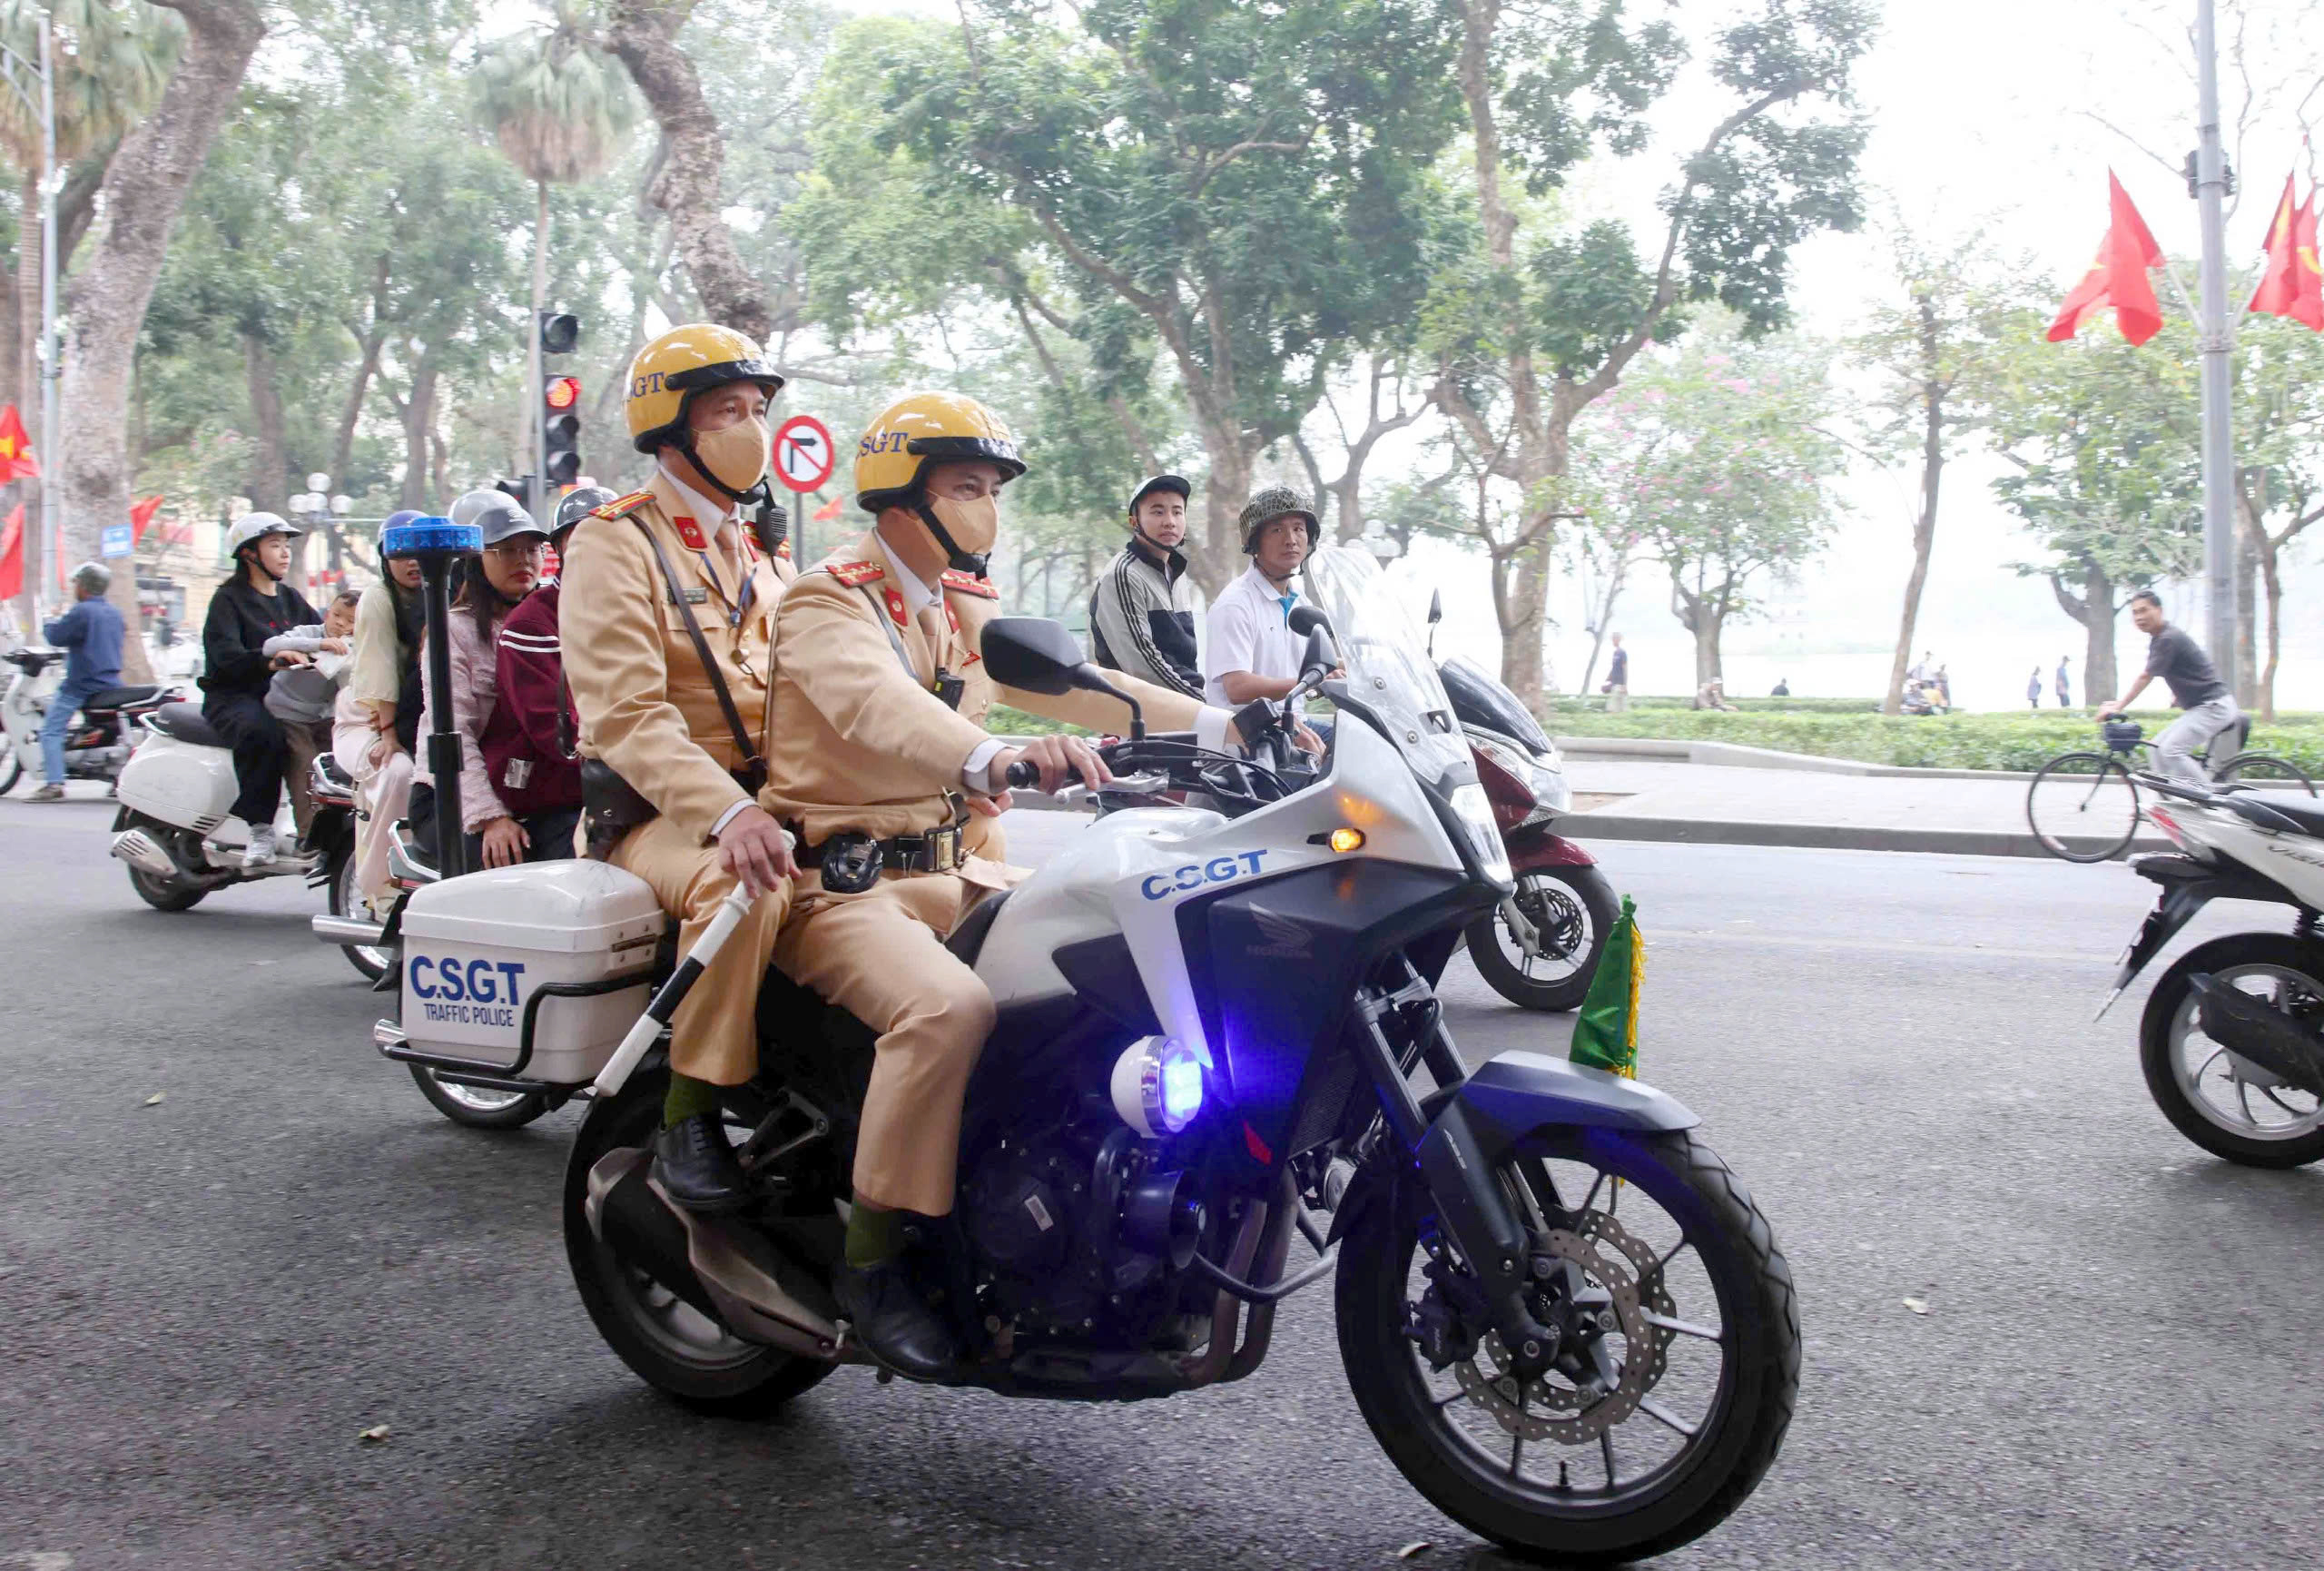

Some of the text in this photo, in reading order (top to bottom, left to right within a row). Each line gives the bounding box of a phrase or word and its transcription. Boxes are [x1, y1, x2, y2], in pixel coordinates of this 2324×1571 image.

[856, 432, 908, 459] SGT
[1141, 849, 1267, 901] C.S.G.T
[410, 955, 525, 1005] C.S.G.T
[424, 1003, 515, 1027] TRAFFIC POLICE
